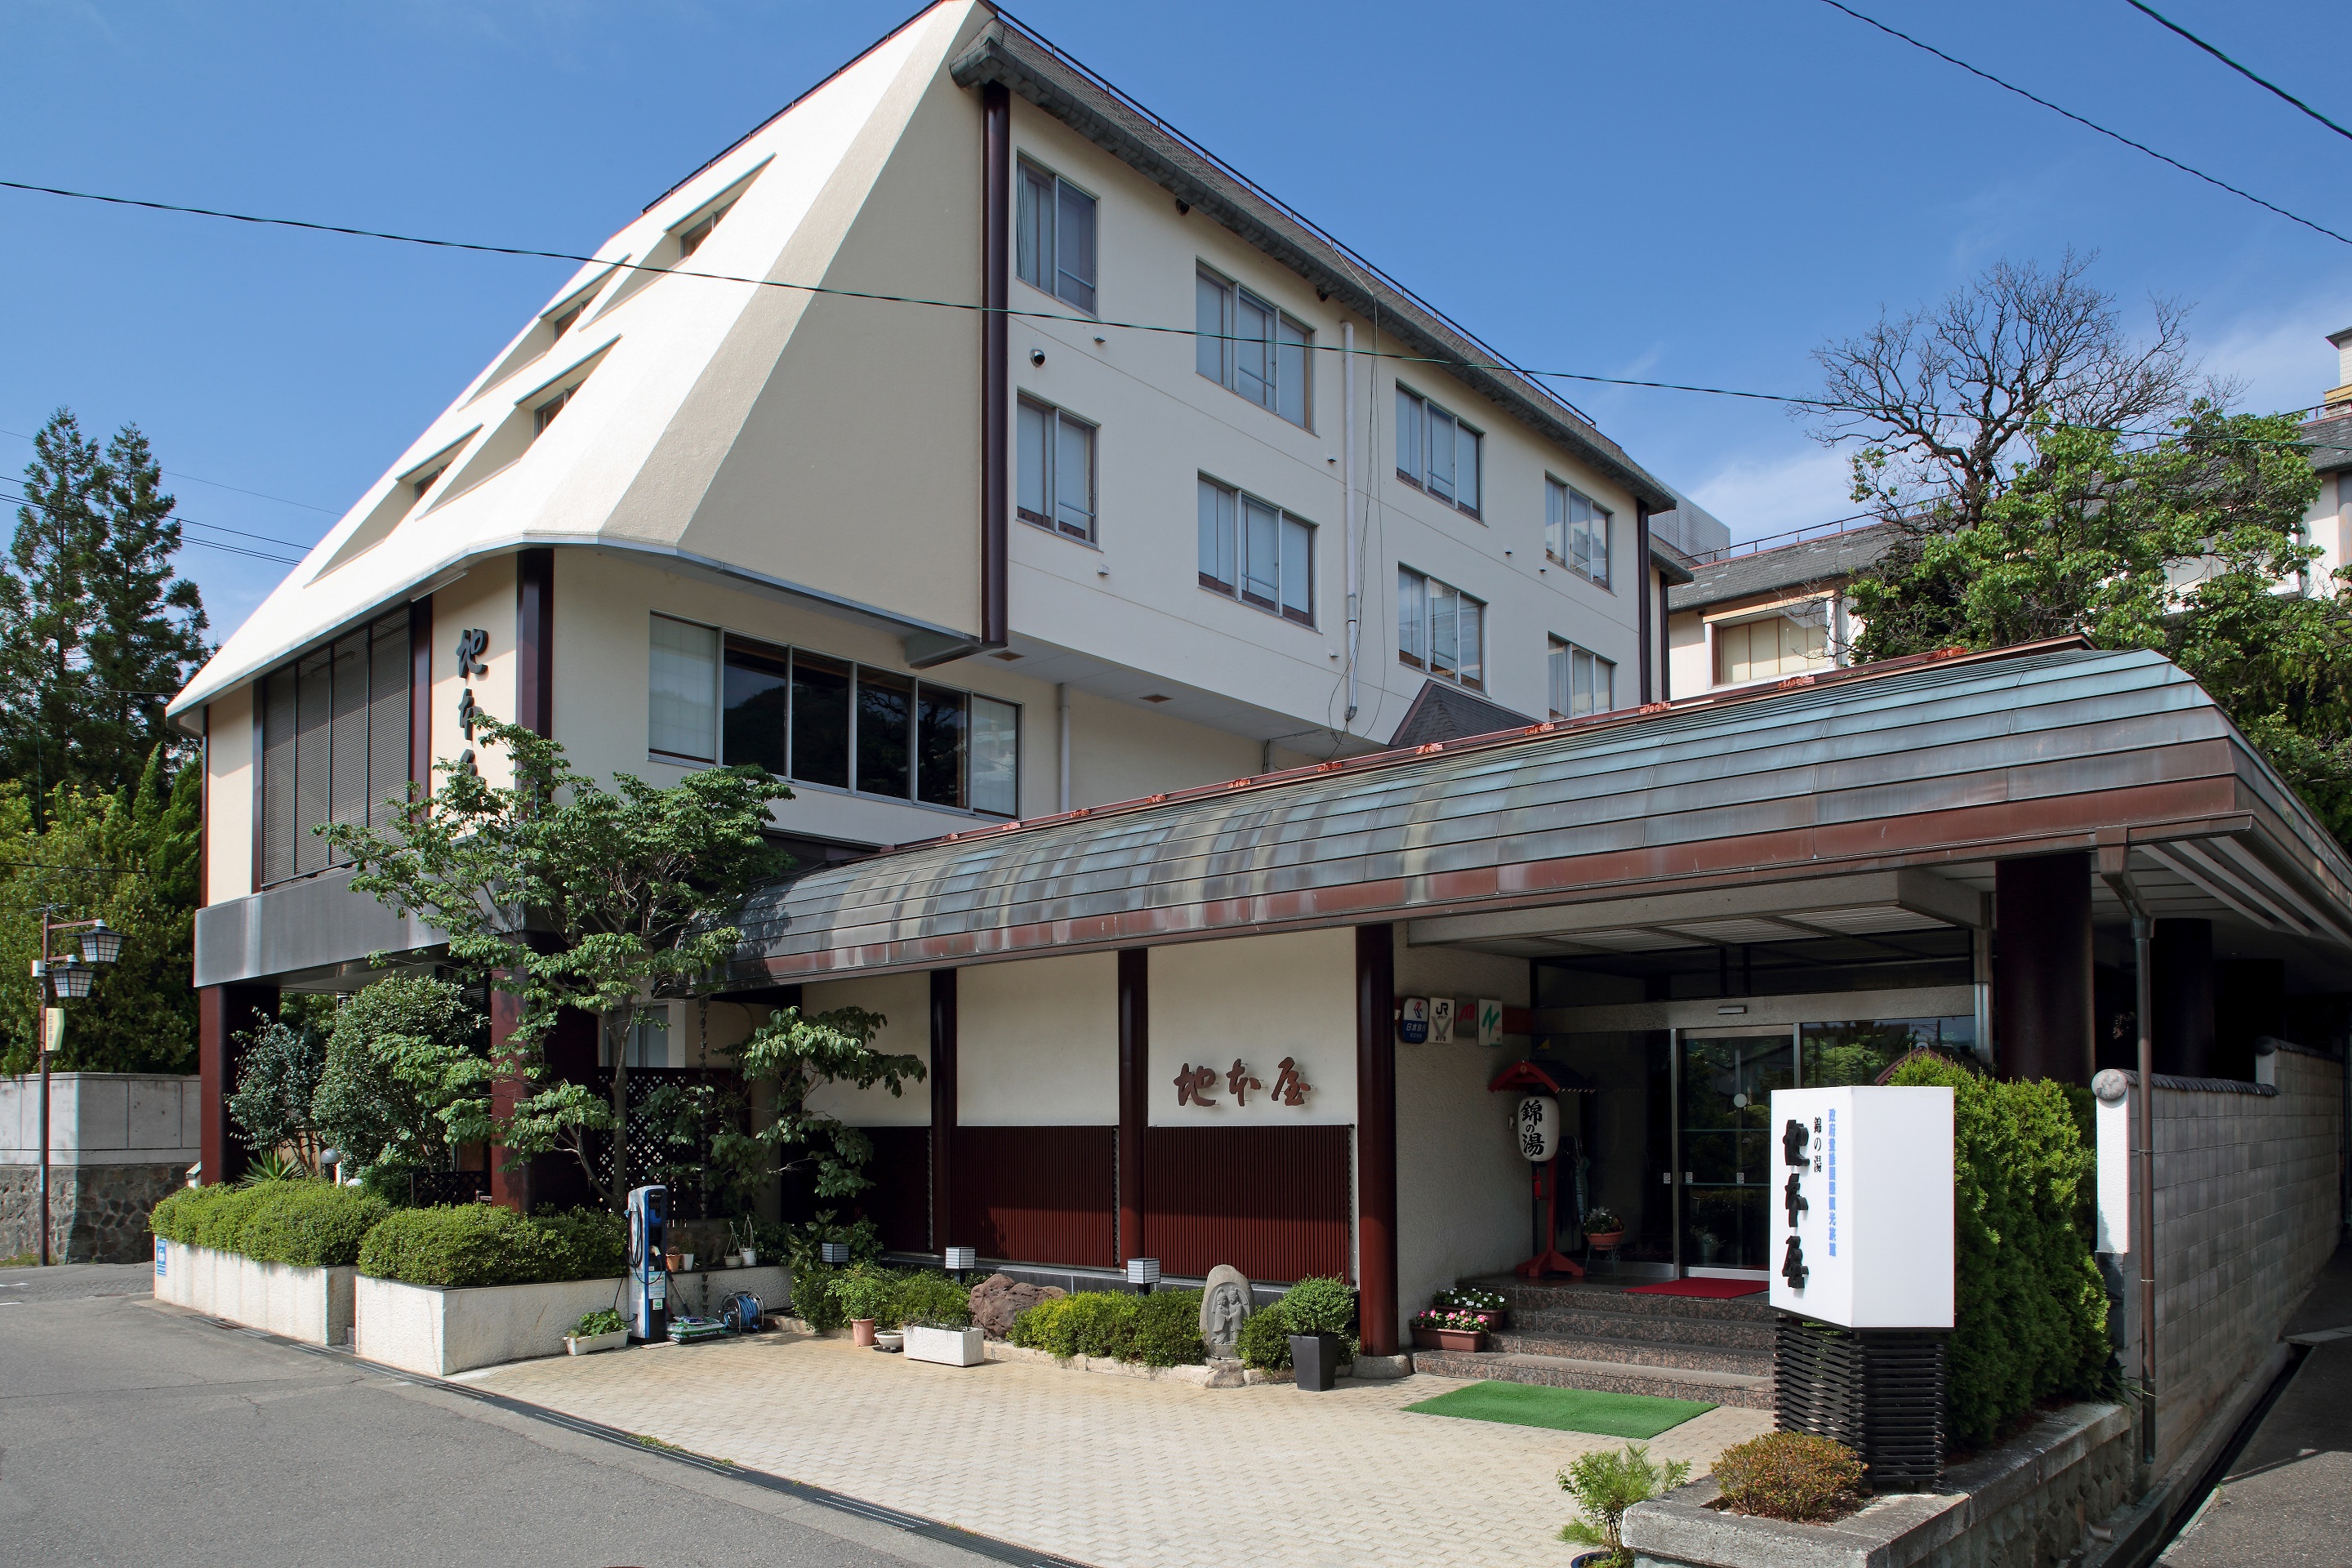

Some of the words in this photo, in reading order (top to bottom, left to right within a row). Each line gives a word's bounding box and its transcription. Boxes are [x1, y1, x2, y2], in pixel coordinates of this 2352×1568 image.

[1405, 1023, 1427, 1032] 日本旅行
[1436, 1002, 1449, 1016] JR
[1174, 1057, 1312, 1107] 地本屋
[1521, 1099, 1545, 1157] 錦の湯
[1813, 1116, 1822, 1173] 錦の湯
[1780, 1119, 1811, 1289] 地本屋
